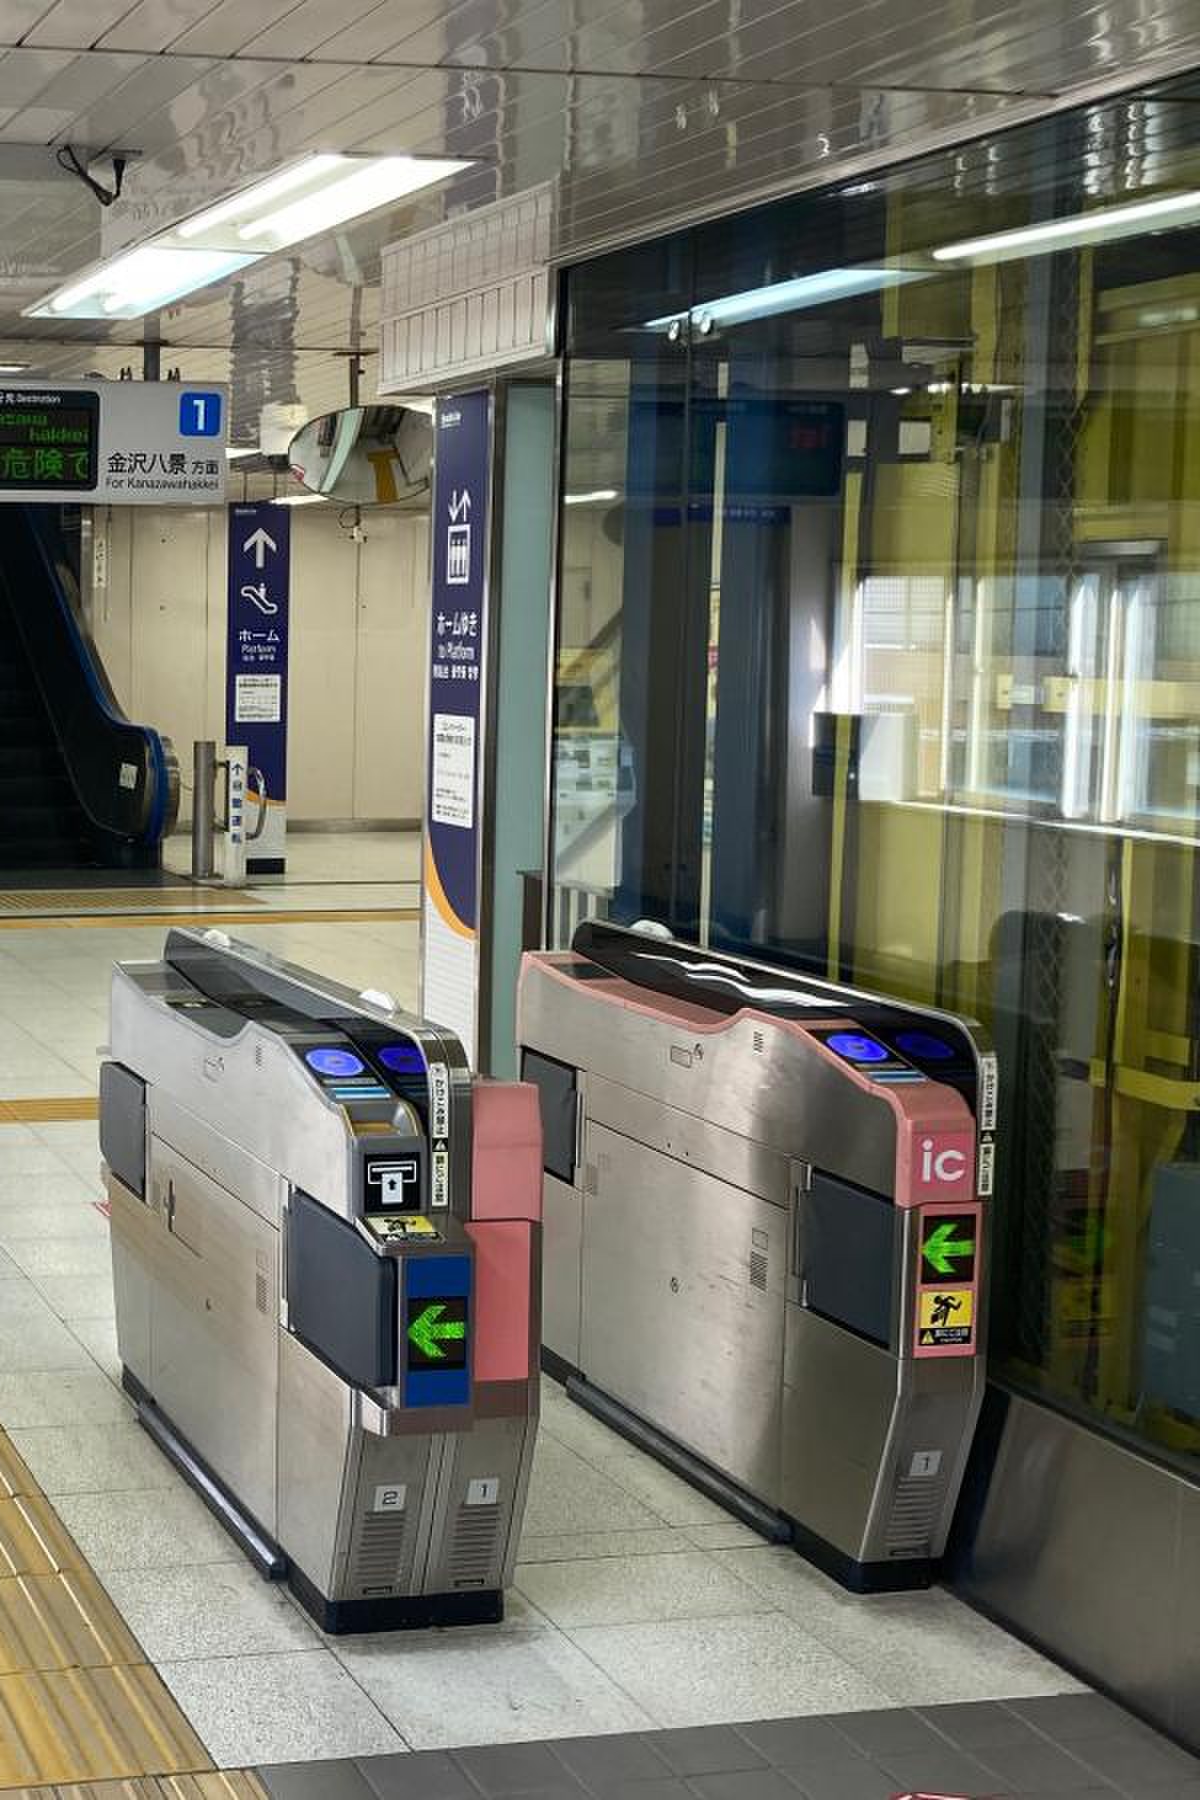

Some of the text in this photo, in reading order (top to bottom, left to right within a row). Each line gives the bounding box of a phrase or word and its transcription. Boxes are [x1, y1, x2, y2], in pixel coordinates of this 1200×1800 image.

[193, 399, 205, 431] 1
[108, 453, 219, 475] 金沢八景 方面
[106, 478, 124, 489] For
[437, 611, 477, 636] ホームゆき
[240, 629, 279, 641] ホーム
[382, 1491, 399, 1505] 2
